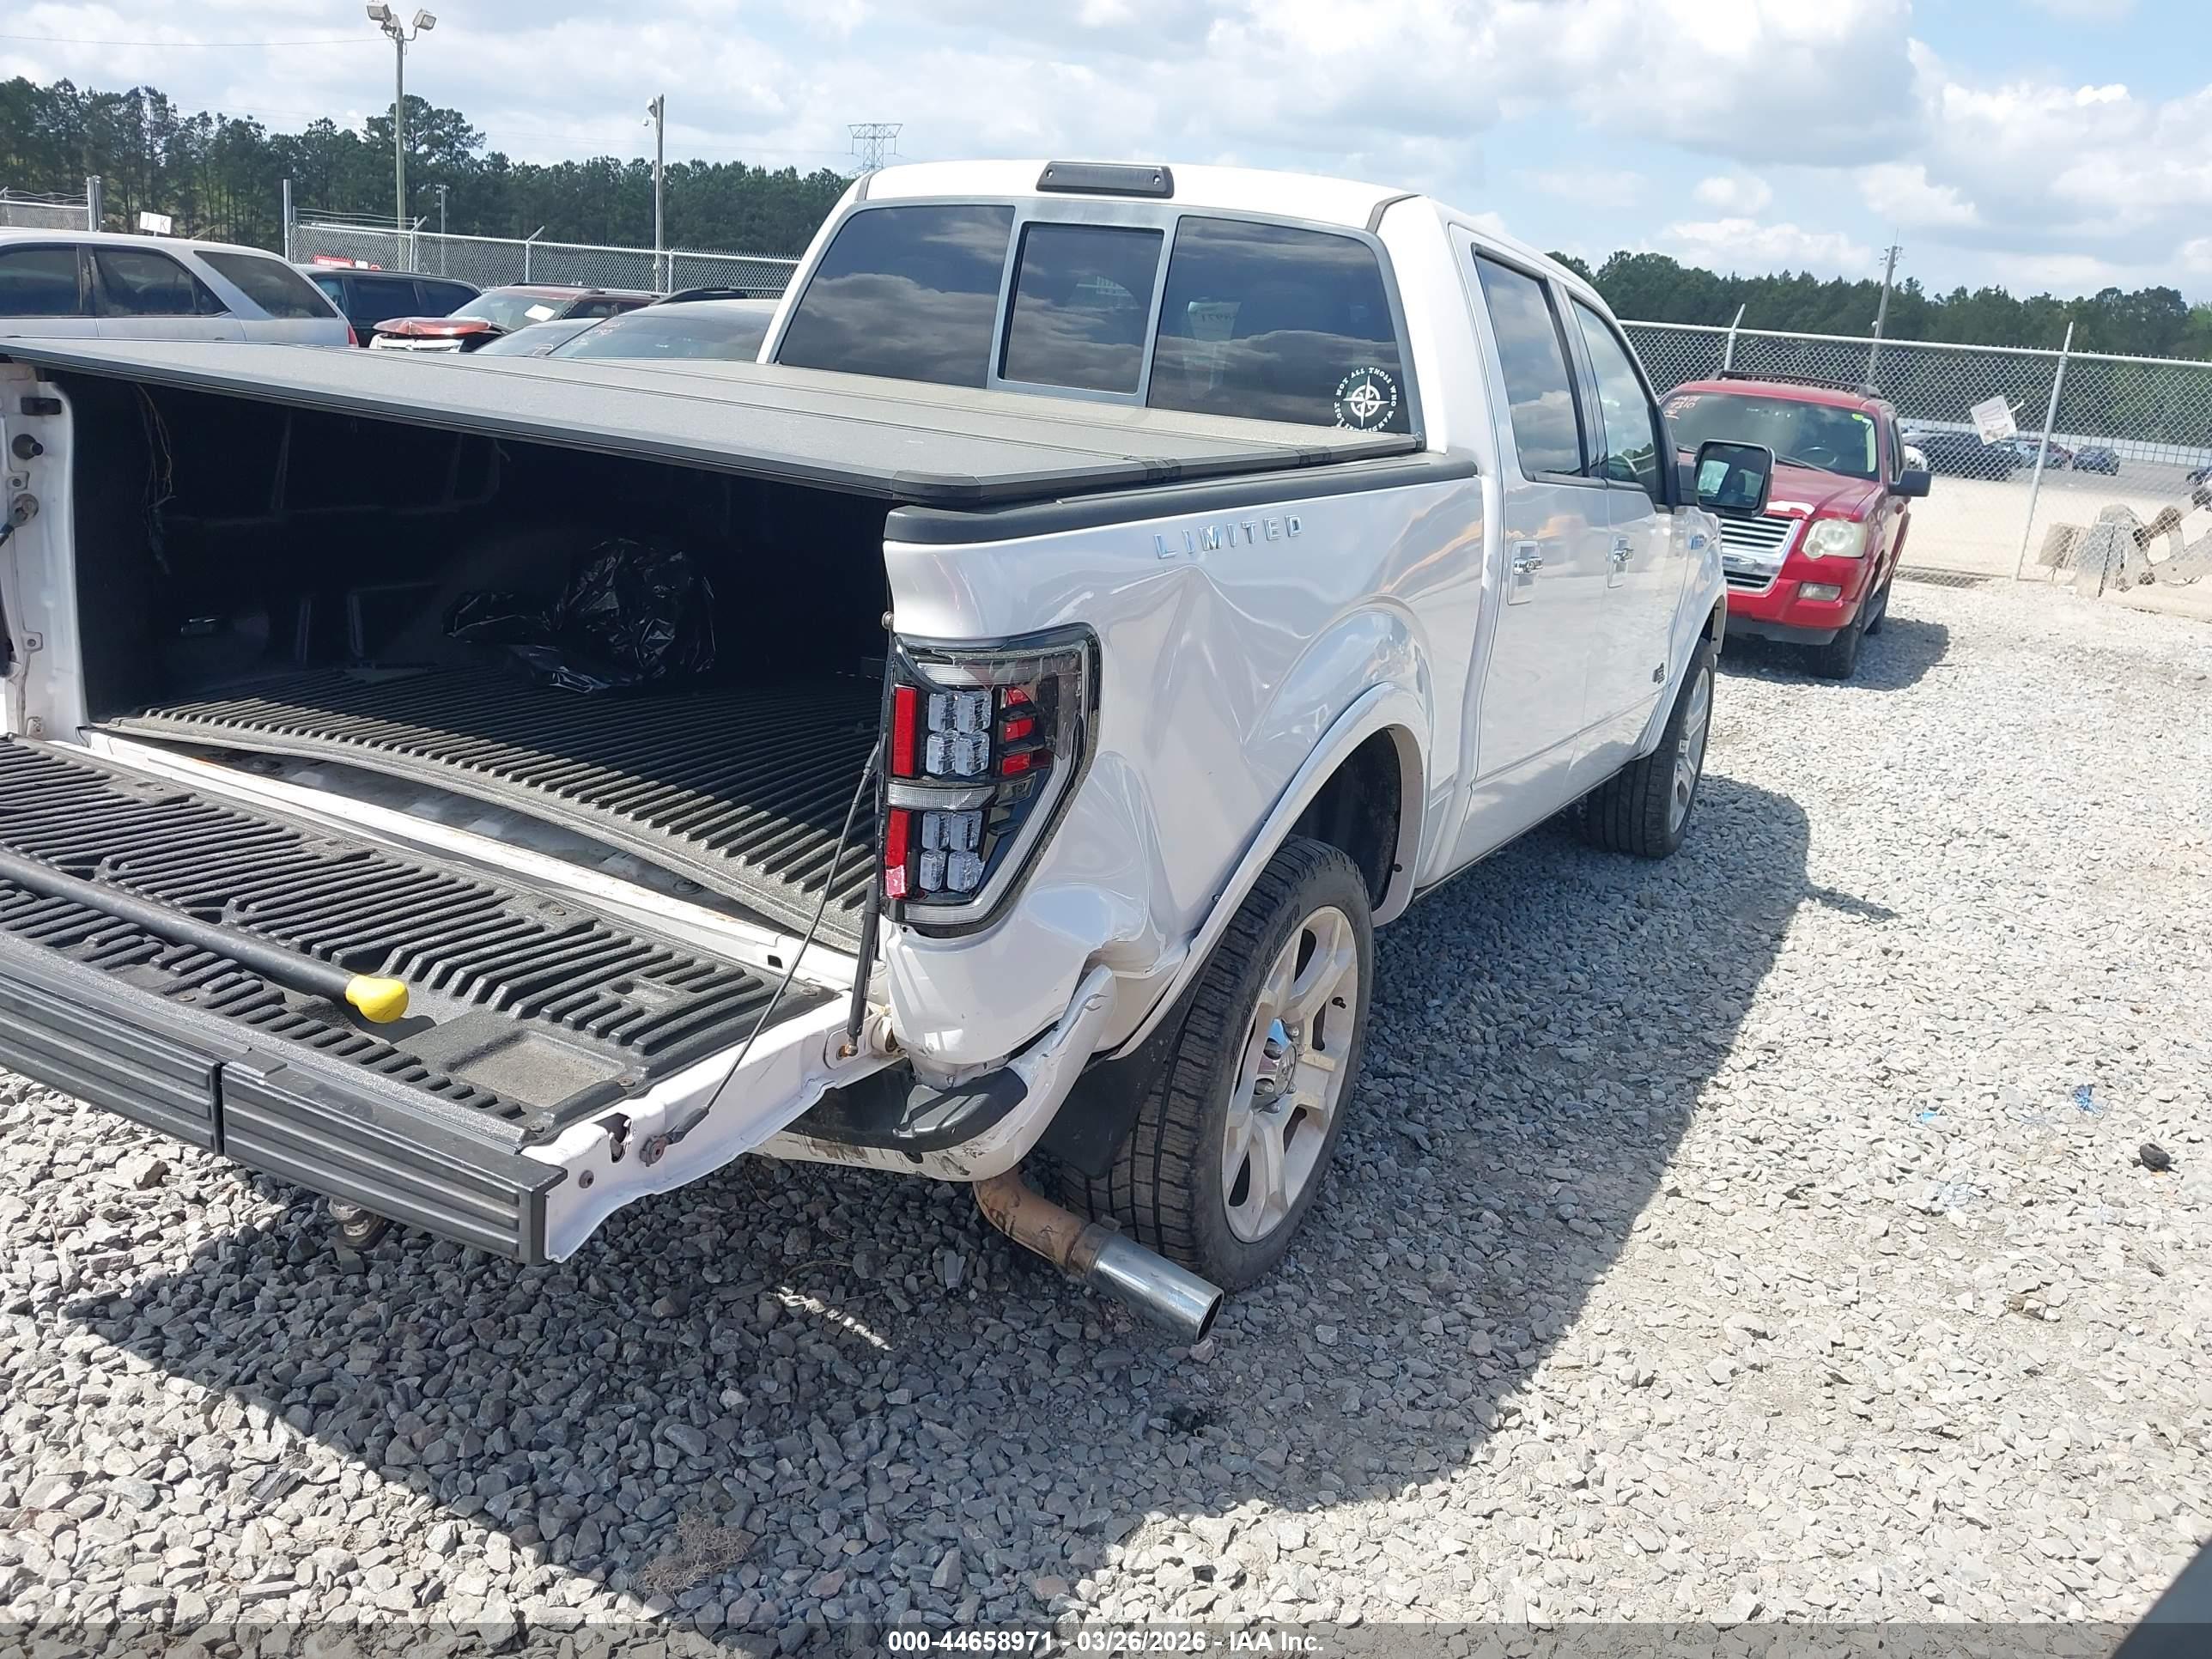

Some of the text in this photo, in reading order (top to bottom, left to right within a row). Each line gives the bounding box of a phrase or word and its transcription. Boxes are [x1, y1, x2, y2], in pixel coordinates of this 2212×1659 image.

[1335, 377, 1349, 396] NOT
[1351, 368, 1365, 379] ALL
[1368, 367, 1393, 385] THOSE
[1389, 385, 1398, 407] WHO
[1153, 514, 1303, 560] LIMITED
